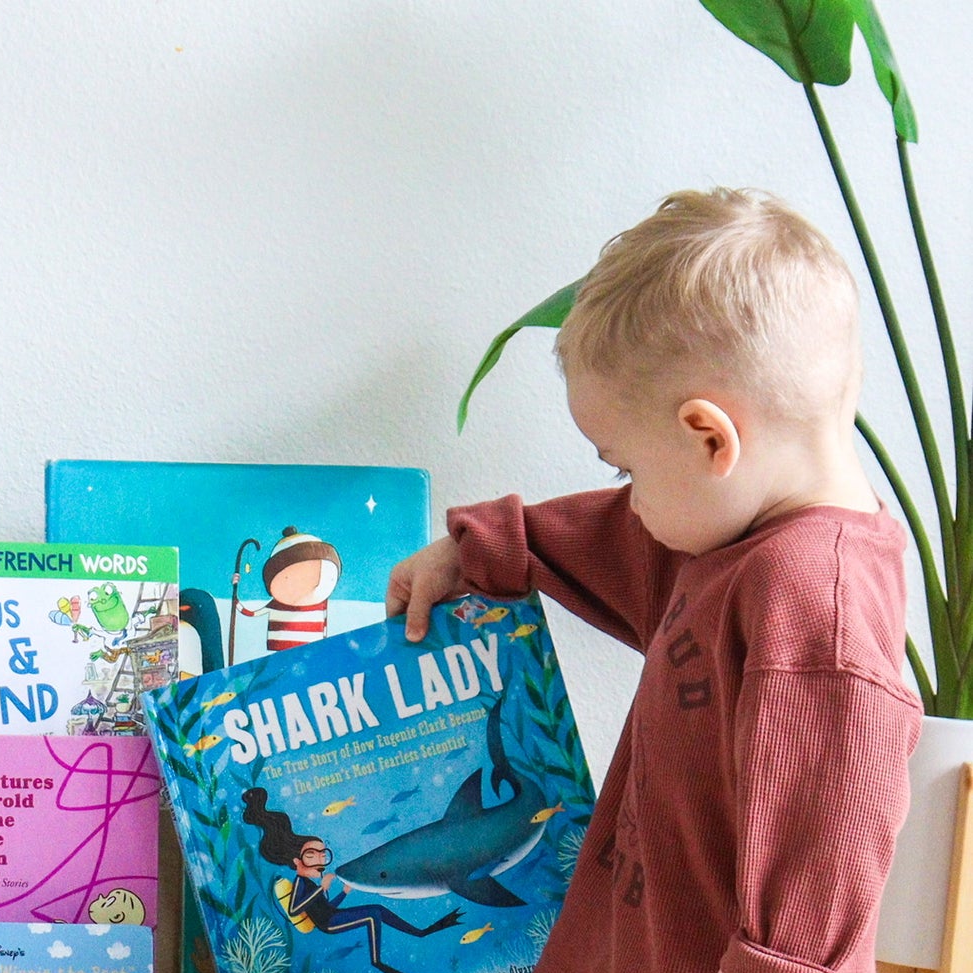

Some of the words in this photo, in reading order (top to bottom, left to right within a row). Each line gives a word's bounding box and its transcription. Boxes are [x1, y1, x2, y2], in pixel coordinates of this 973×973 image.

[79, 553, 148, 575] WORDS
[8, 637, 39, 675] &
[223, 671, 380, 765] SHARK
[384, 633, 506, 719] LADY
[262, 765, 283, 780] The
[283, 757, 309, 774] True
[310, 750, 338, 767] Story
[340, 746, 351, 759] of
[352, 739, 375, 756] How
[377, 727, 417, 748] Eugenie
[419, 718, 447, 736] Clark
[447, 708, 487, 727] Became
[353, 762, 377, 778] Most
[378, 750, 420, 771] Fearless
[420, 736, 468, 757] Scientist
[1, 878, 29, 888] Stories
